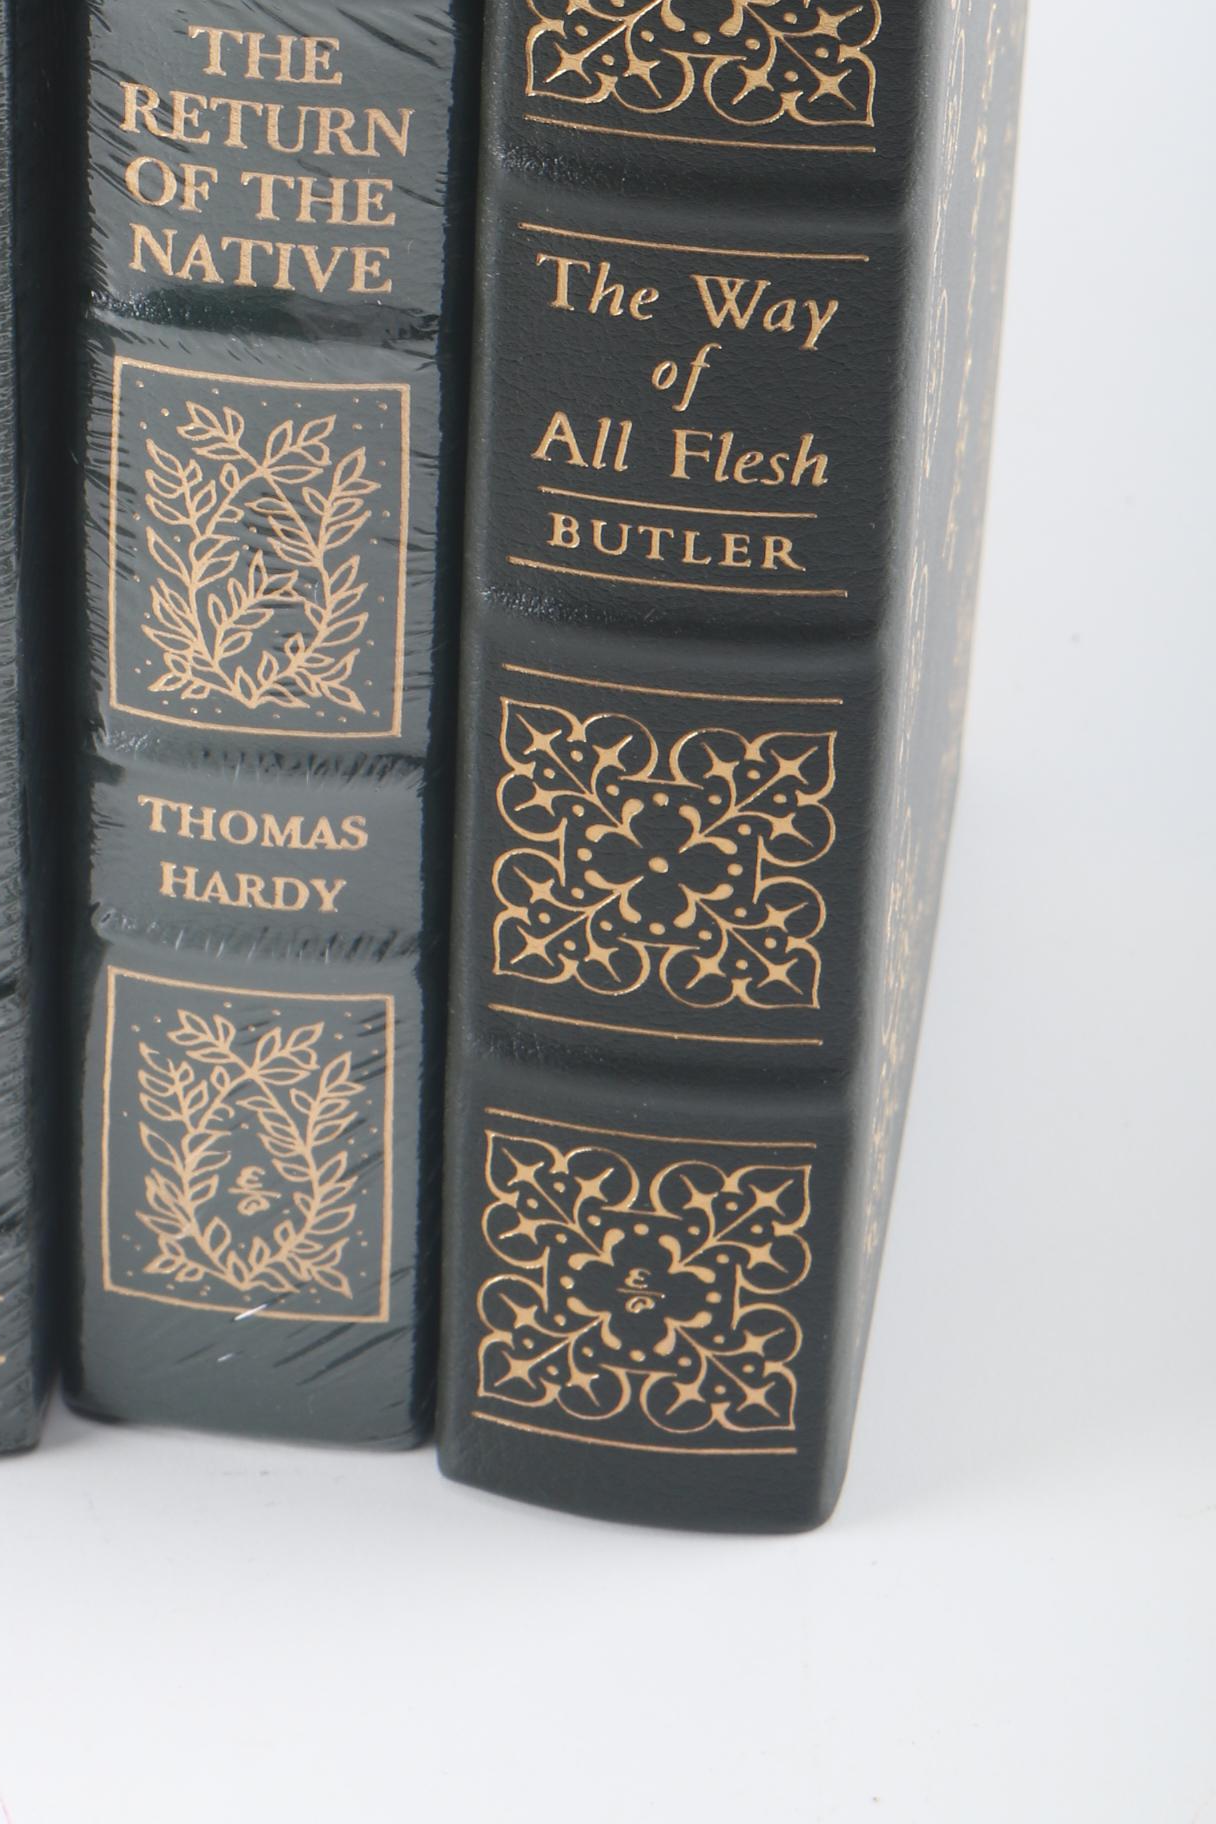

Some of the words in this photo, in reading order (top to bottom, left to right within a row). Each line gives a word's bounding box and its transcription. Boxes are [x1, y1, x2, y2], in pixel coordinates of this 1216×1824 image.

[187, 25, 343, 85] THE
[118, 80, 416, 158] RETURN
[124, 155, 218, 213] OF
[240, 171, 396, 226] THE
[128, 223, 393, 294] NATIVE
[536, 252, 659, 321] The
[689, 273, 839, 351] Way
[651, 342, 722, 412] of
[530, 410, 633, 472] All
[669, 428, 829, 487] Flesh
[546, 511, 806, 572] BUTLER
[137, 793, 369, 851] THOMAS
[159, 860, 347, 913] HARDY
